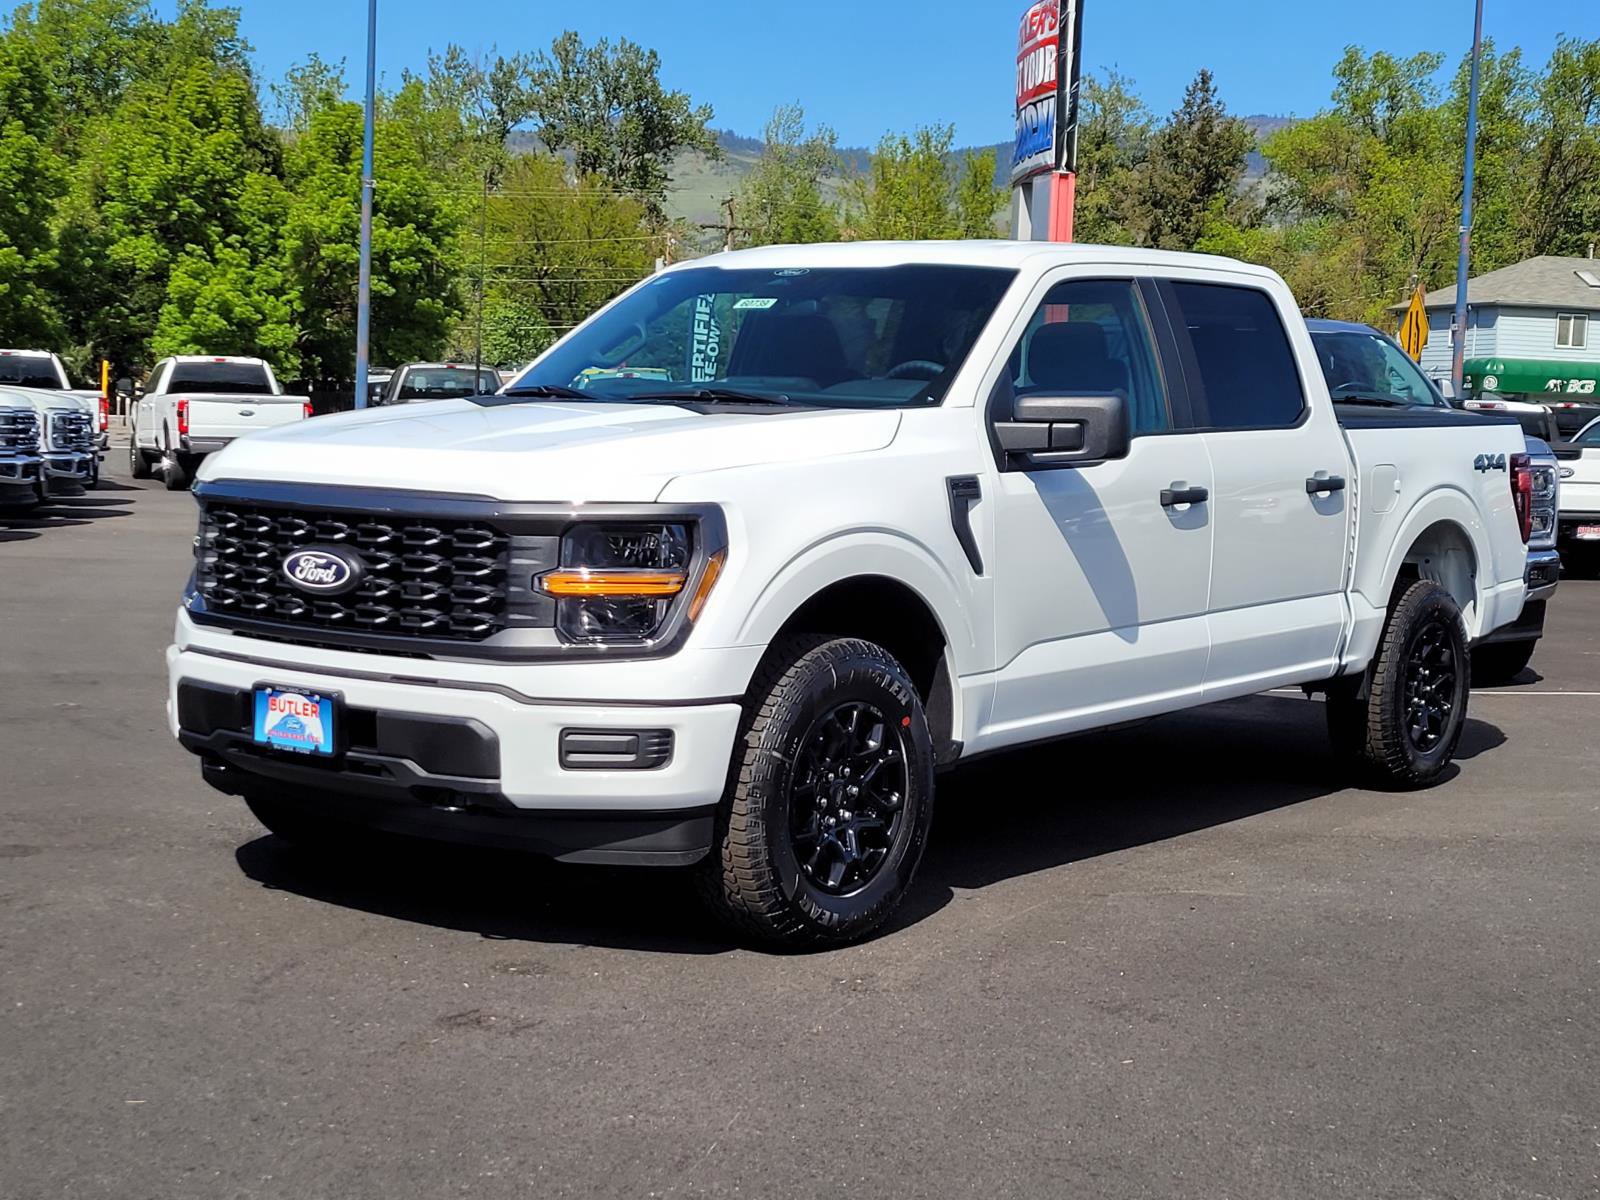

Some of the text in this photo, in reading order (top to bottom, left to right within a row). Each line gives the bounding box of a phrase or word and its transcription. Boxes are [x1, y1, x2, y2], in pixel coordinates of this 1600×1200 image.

[1023, 44, 1056, 92] YOUR
[692, 292, 711, 382] ERTIFIE
[295, 555, 337, 582] Ford
[268, 697, 319, 718] BUTLER
